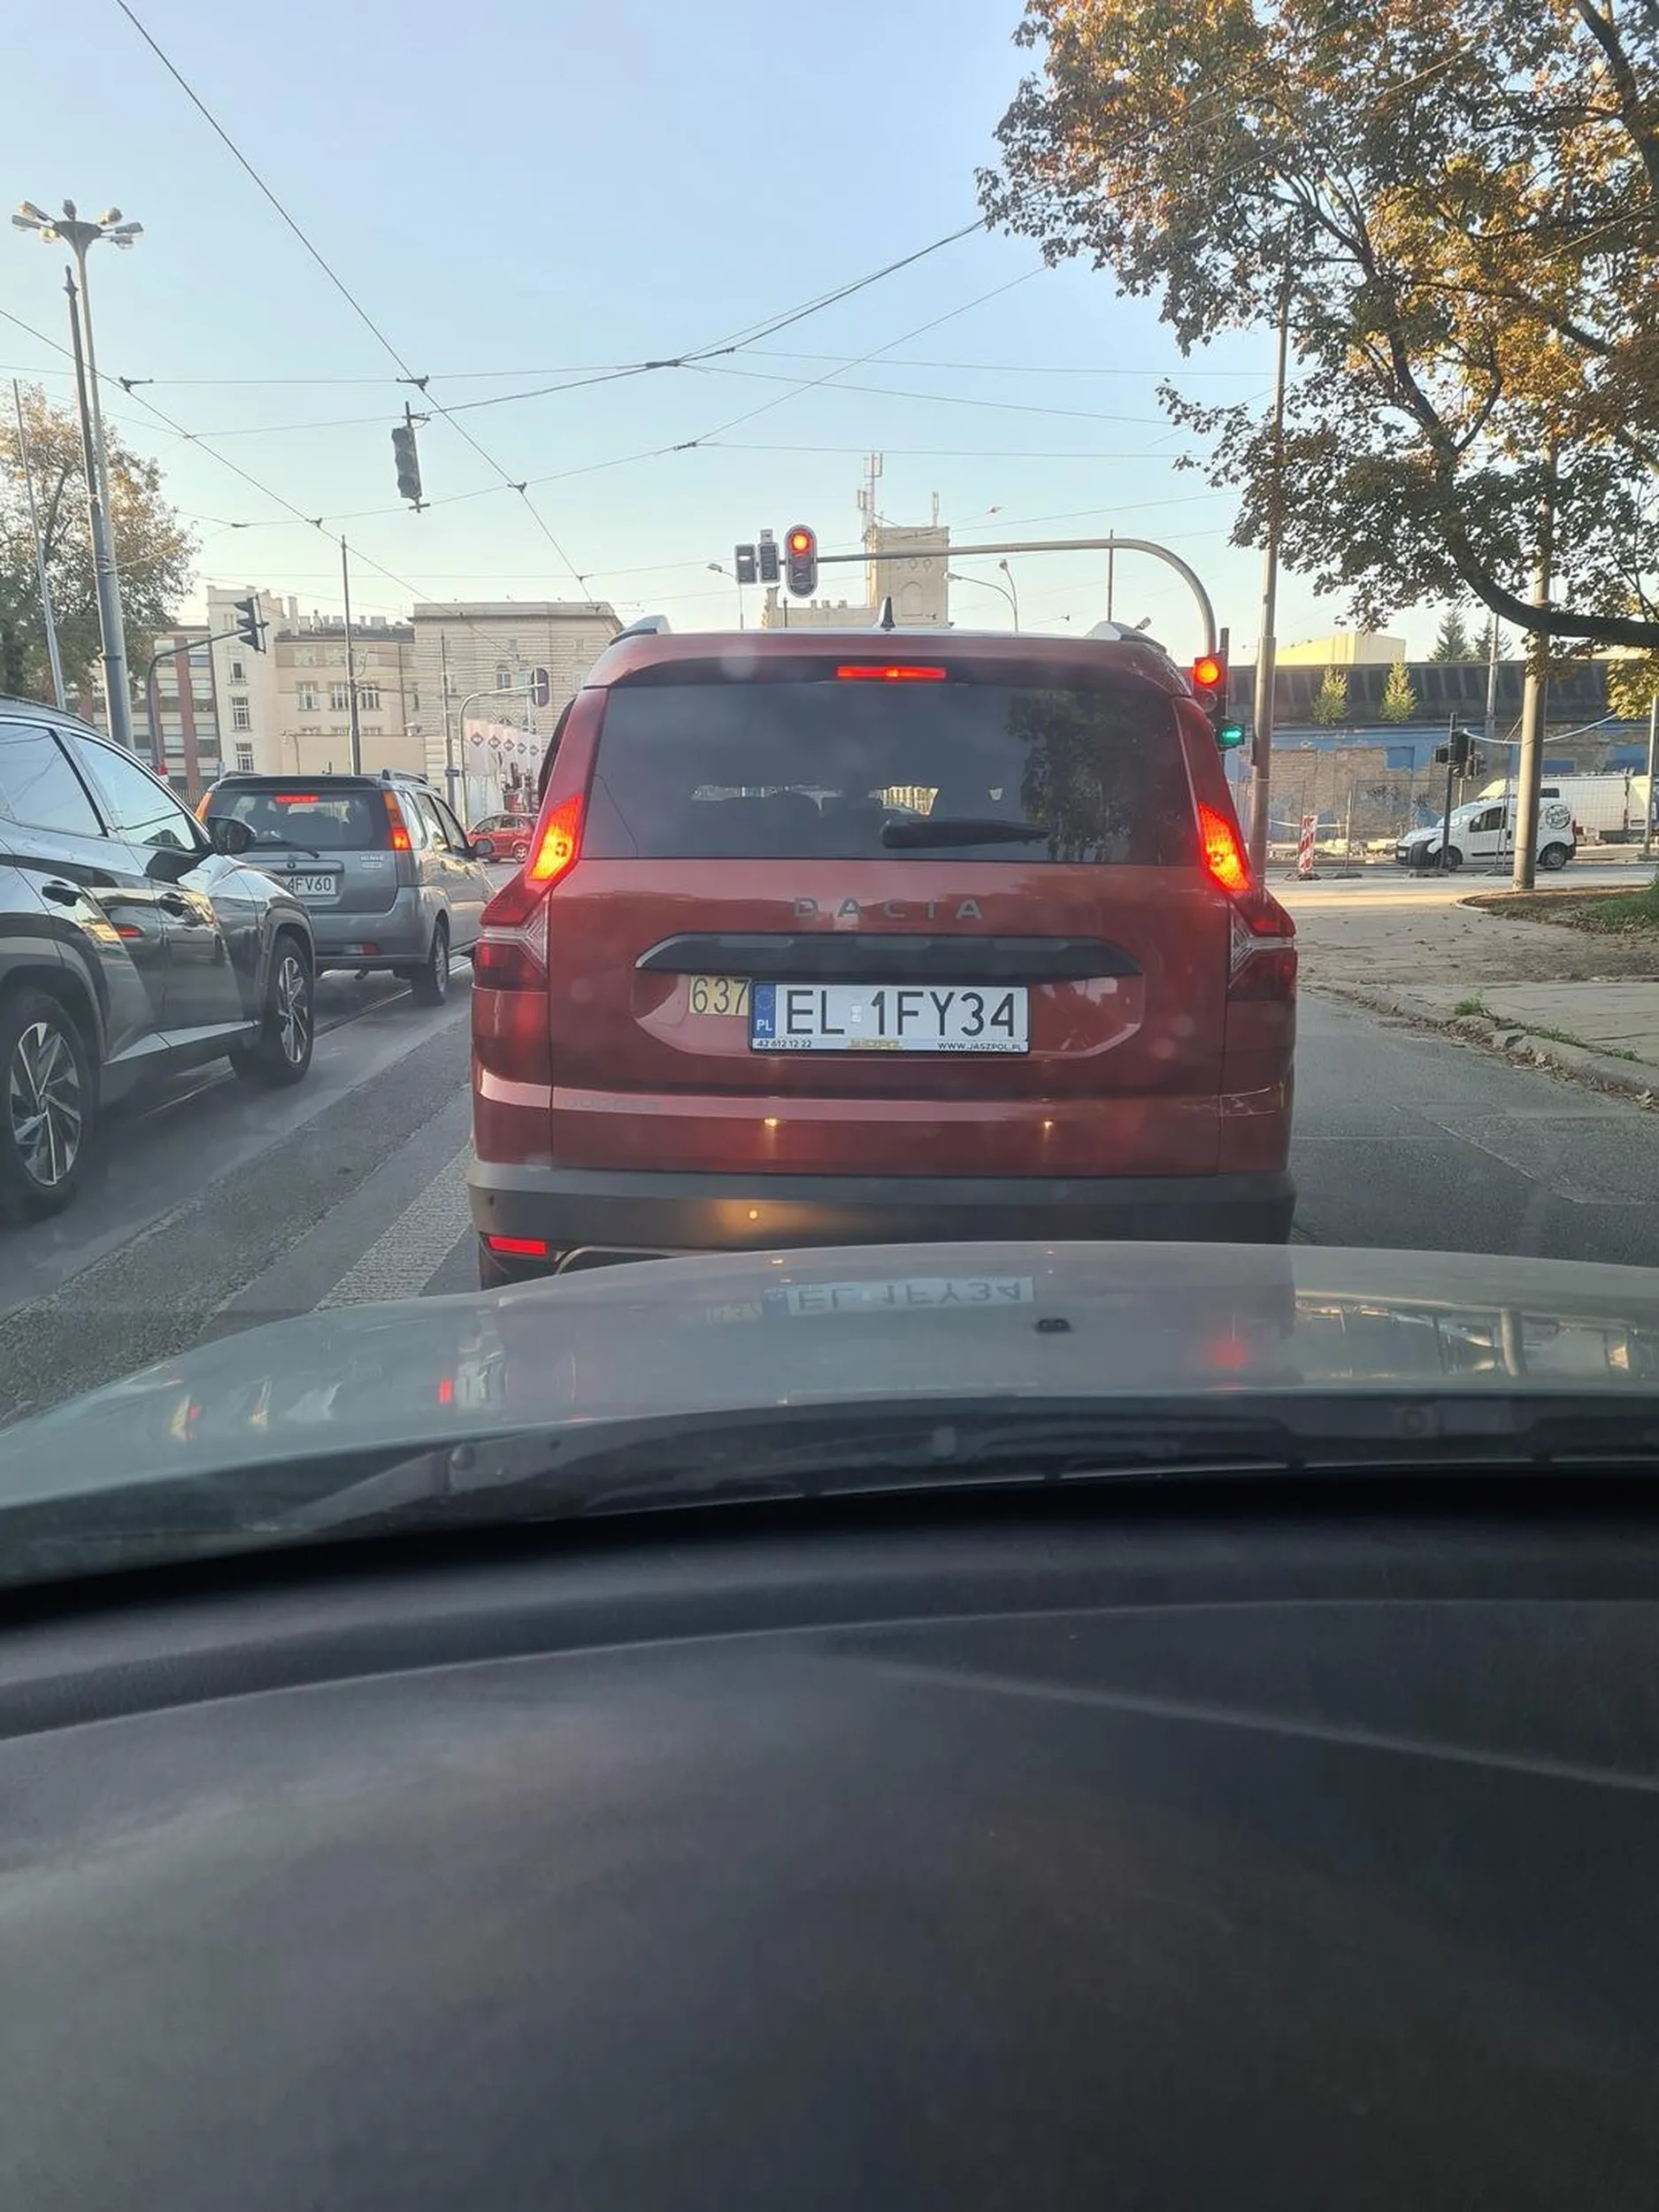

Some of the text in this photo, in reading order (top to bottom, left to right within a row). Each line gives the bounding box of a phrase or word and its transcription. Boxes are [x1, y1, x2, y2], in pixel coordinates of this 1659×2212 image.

[794, 896, 983, 919] DACIA
[692, 977, 751, 1014] 637
[757, 1018, 773, 1032] PL
[787, 990, 1015, 1037] EL 1FY34
[802, 1040, 812, 1048] 22
